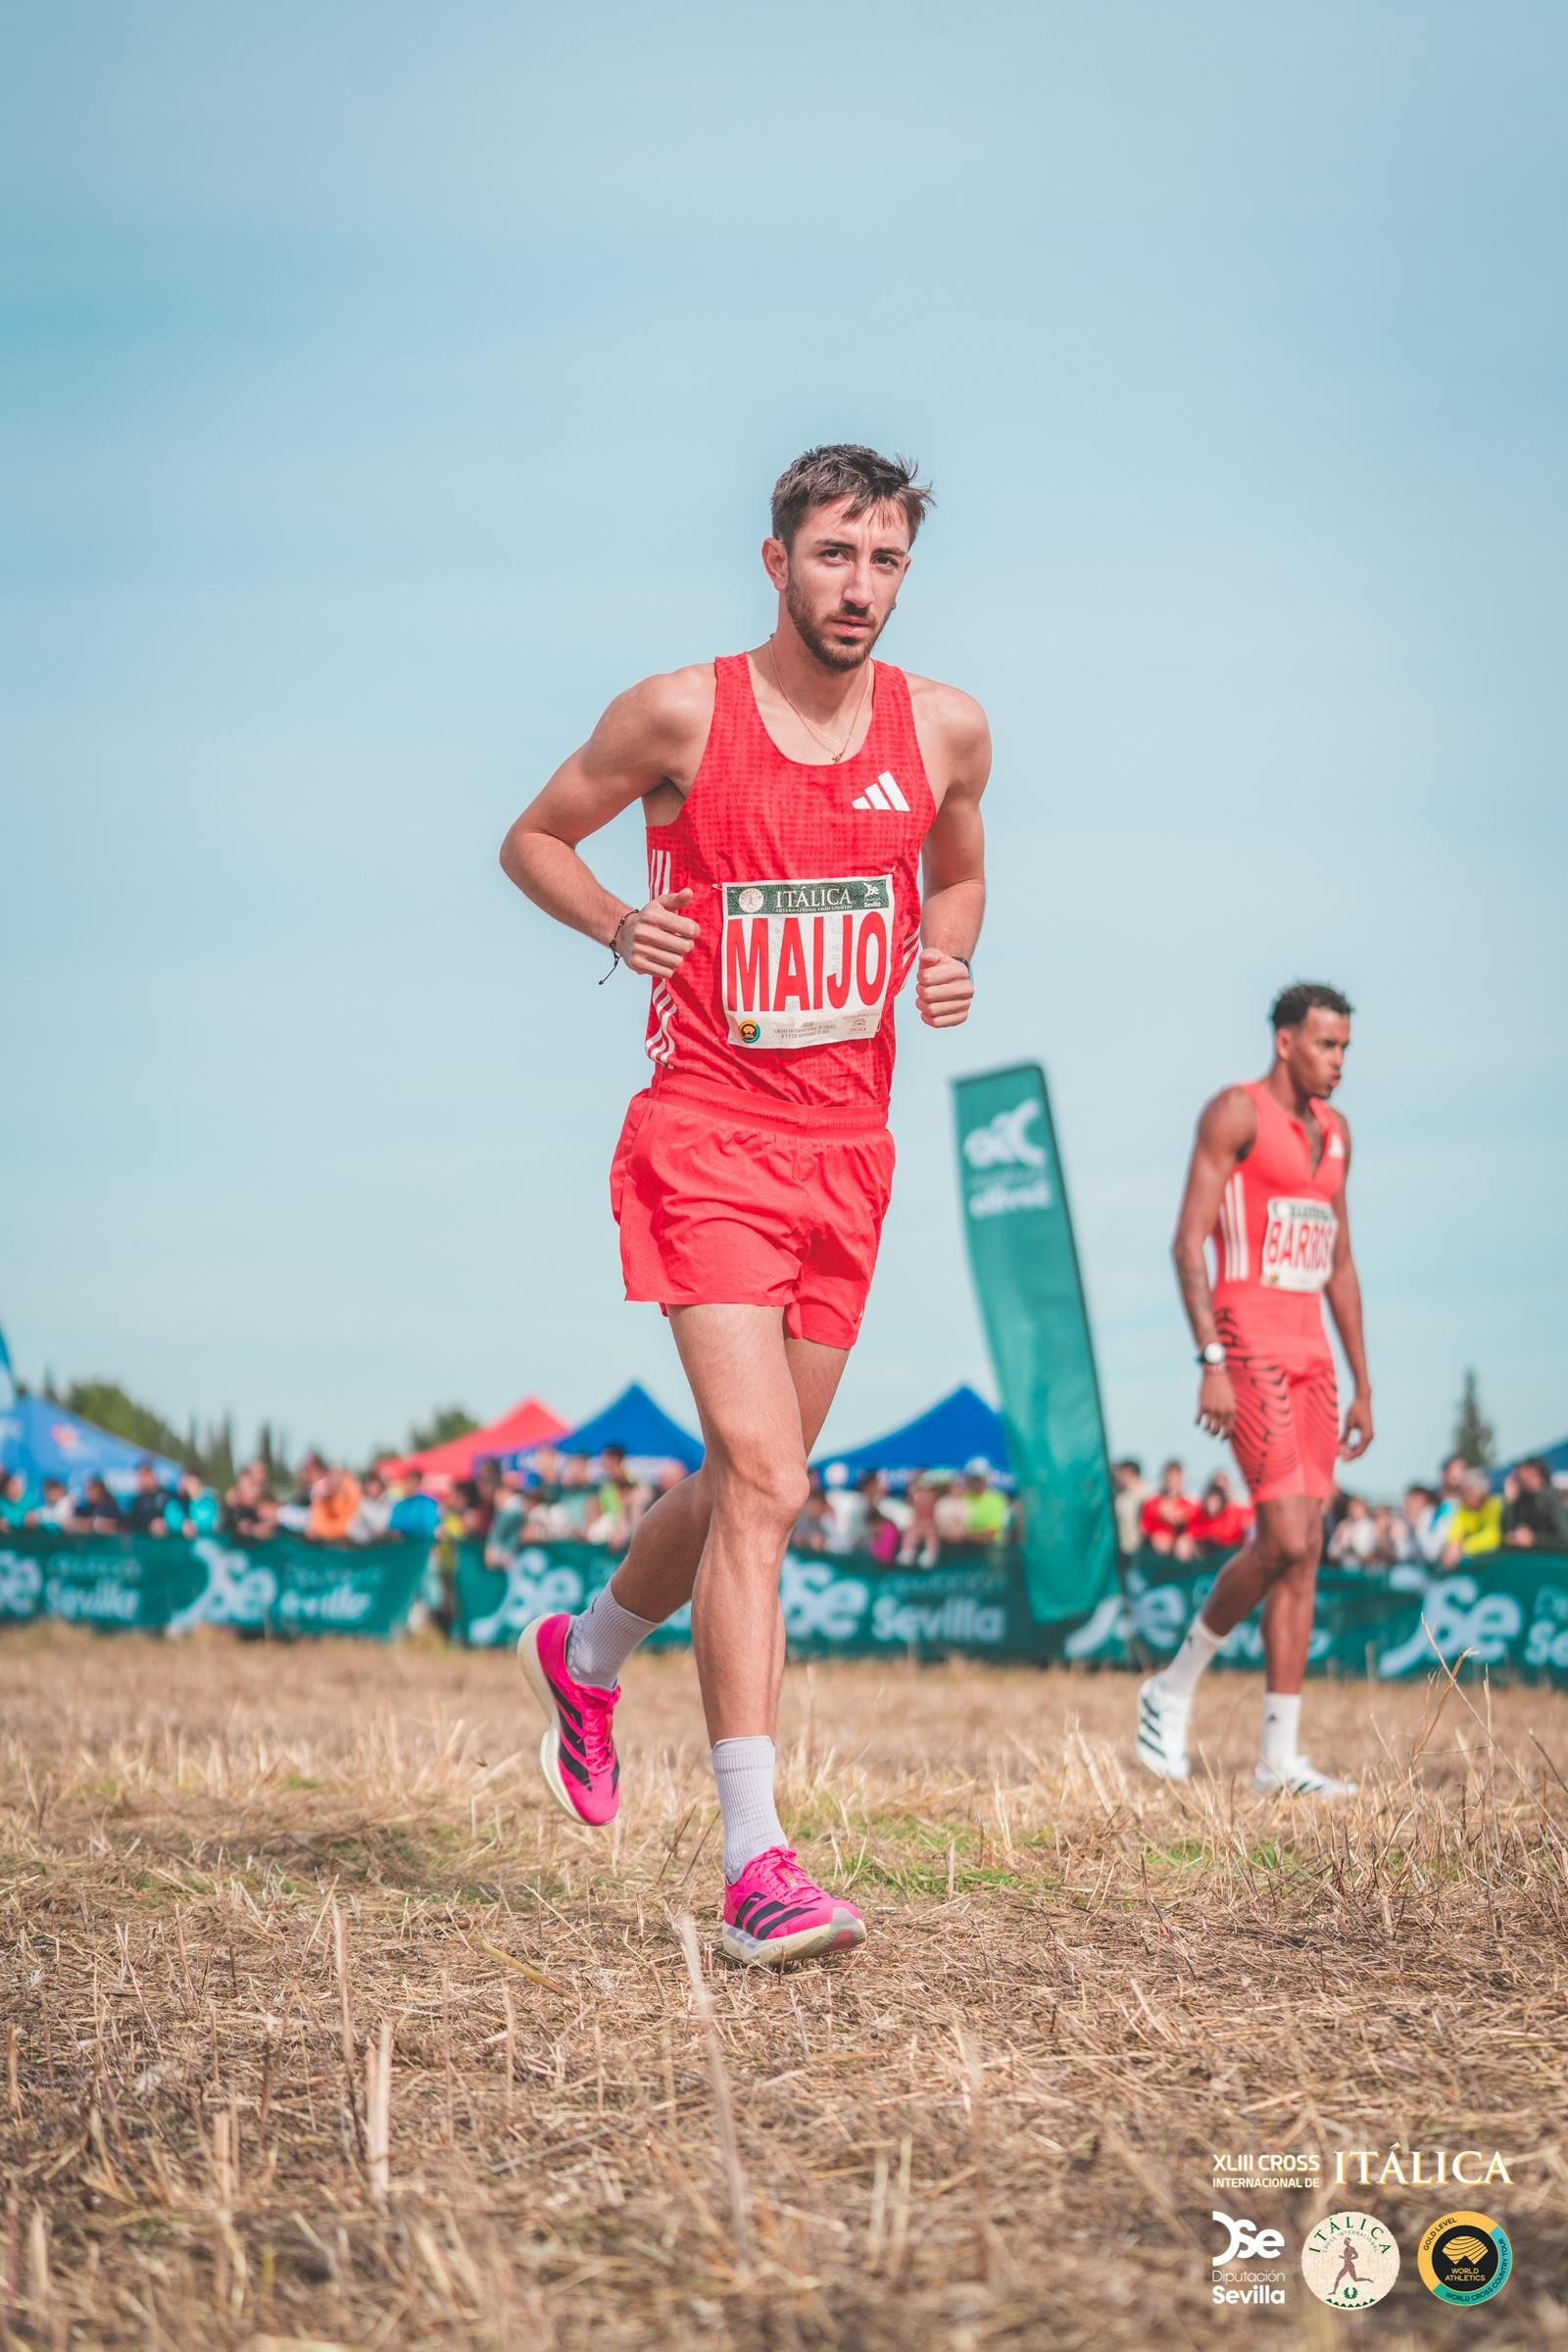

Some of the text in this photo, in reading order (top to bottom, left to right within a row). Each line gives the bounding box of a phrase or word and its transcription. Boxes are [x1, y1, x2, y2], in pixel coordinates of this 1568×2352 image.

[775, 886, 853, 907] ITÁLICA
[726, 910, 887, 1012] MAIJO
[871, 1594, 1006, 1642] Sevilla
